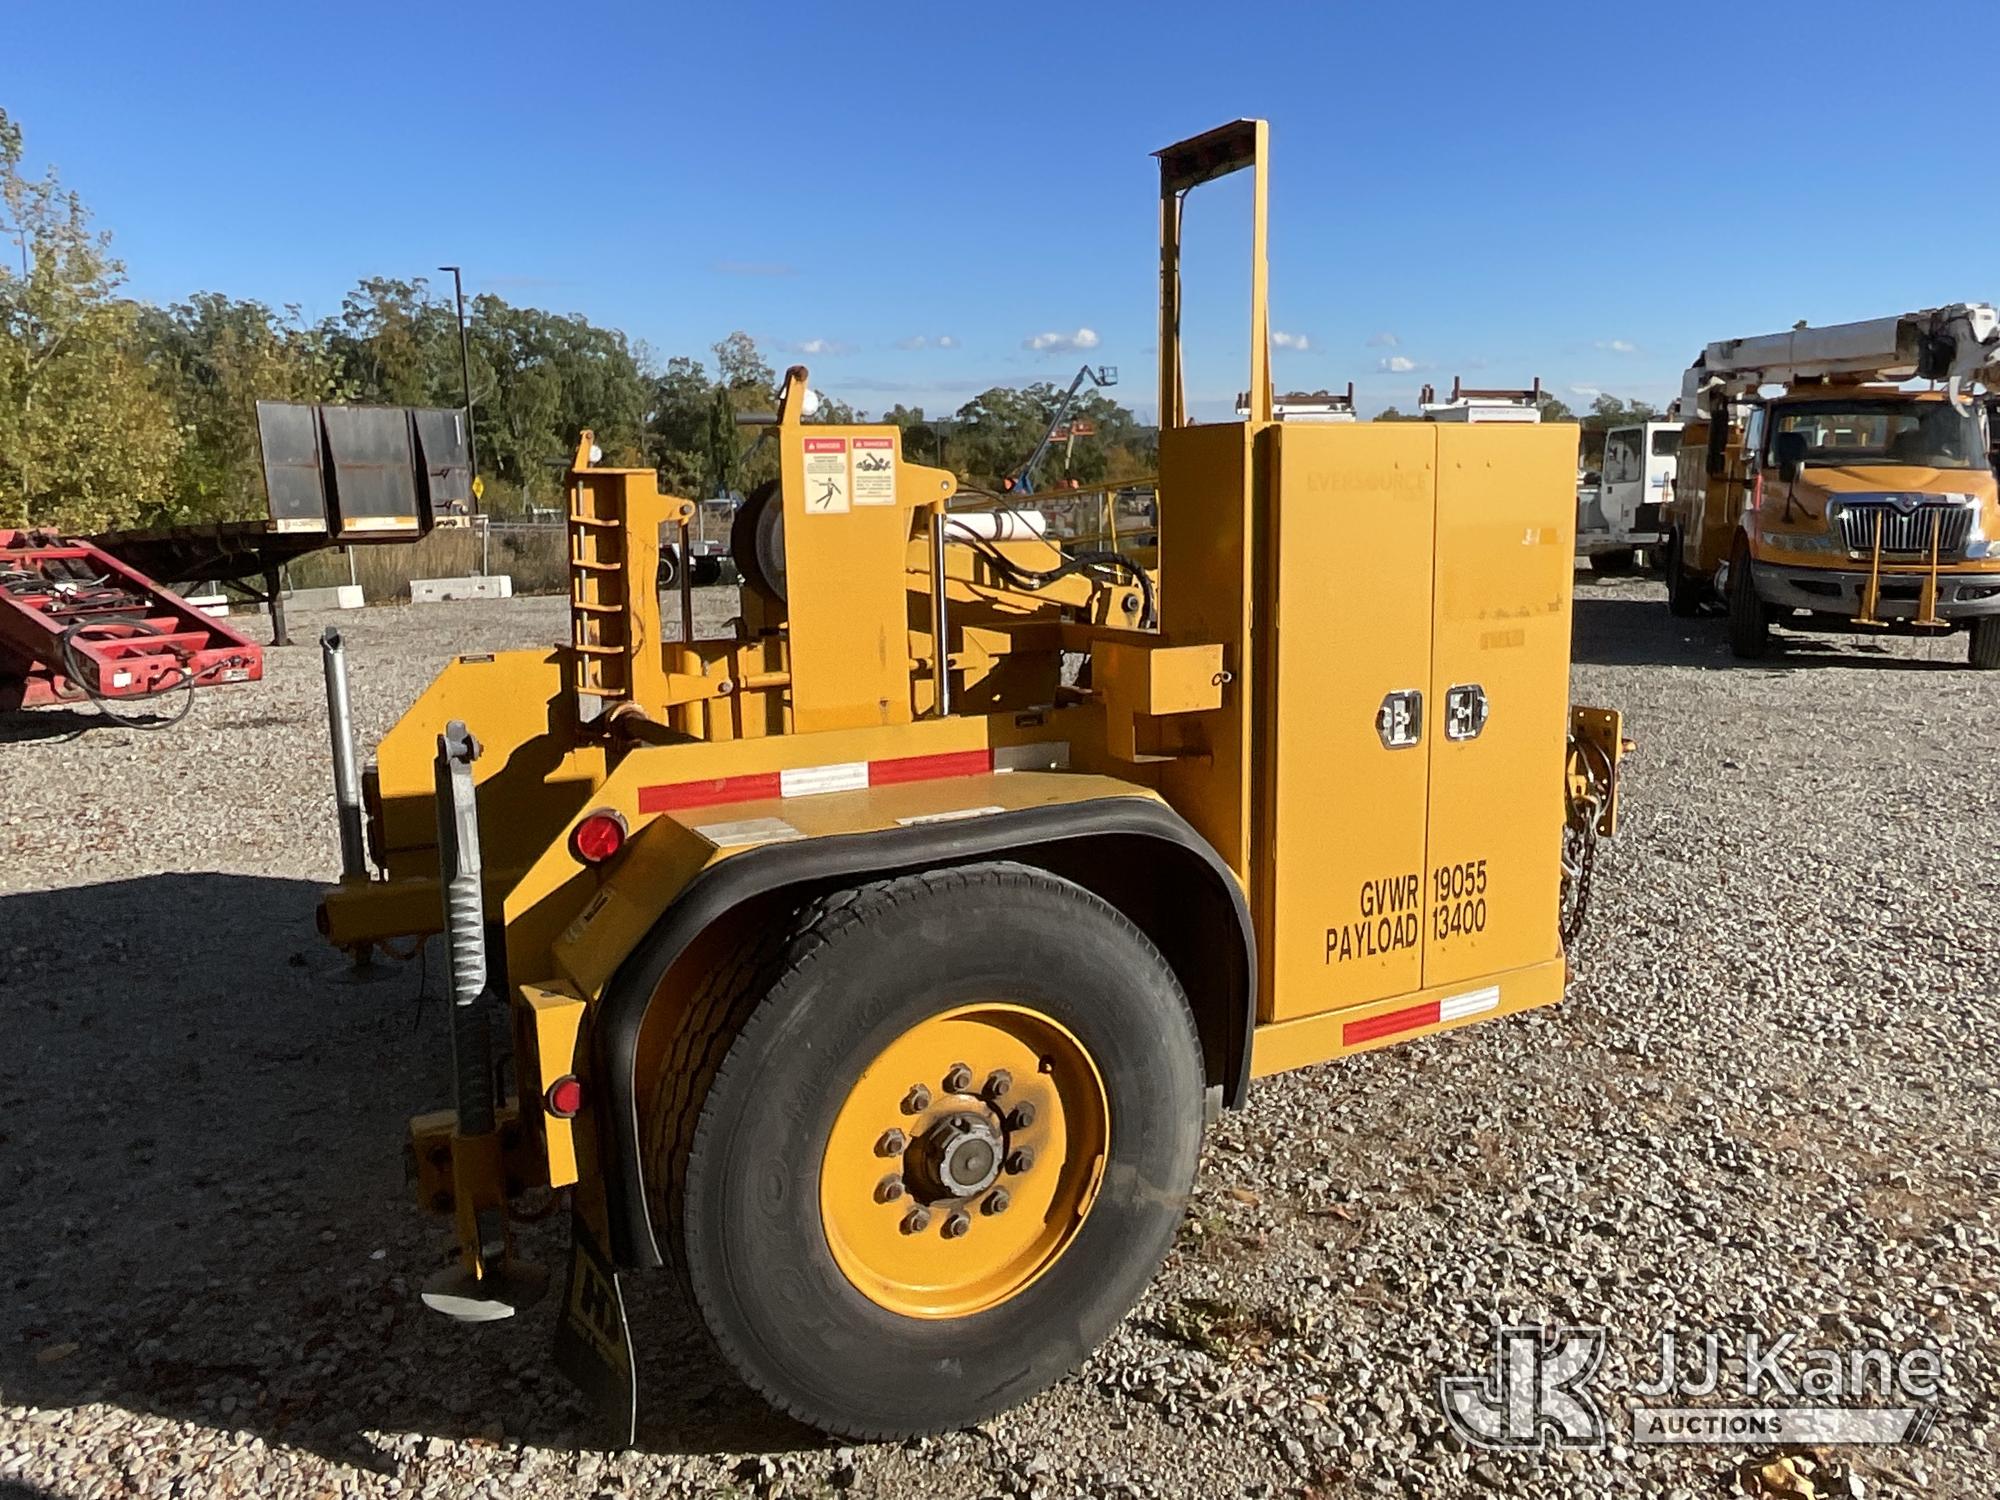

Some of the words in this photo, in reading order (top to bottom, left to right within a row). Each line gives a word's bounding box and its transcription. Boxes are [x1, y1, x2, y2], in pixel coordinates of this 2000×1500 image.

[1360, 874, 1418, 918] GVWR
[1433, 860, 1487, 902] 19055
[1326, 913, 1418, 964] PAYLOAD
[1433, 899, 1487, 940] 13400
